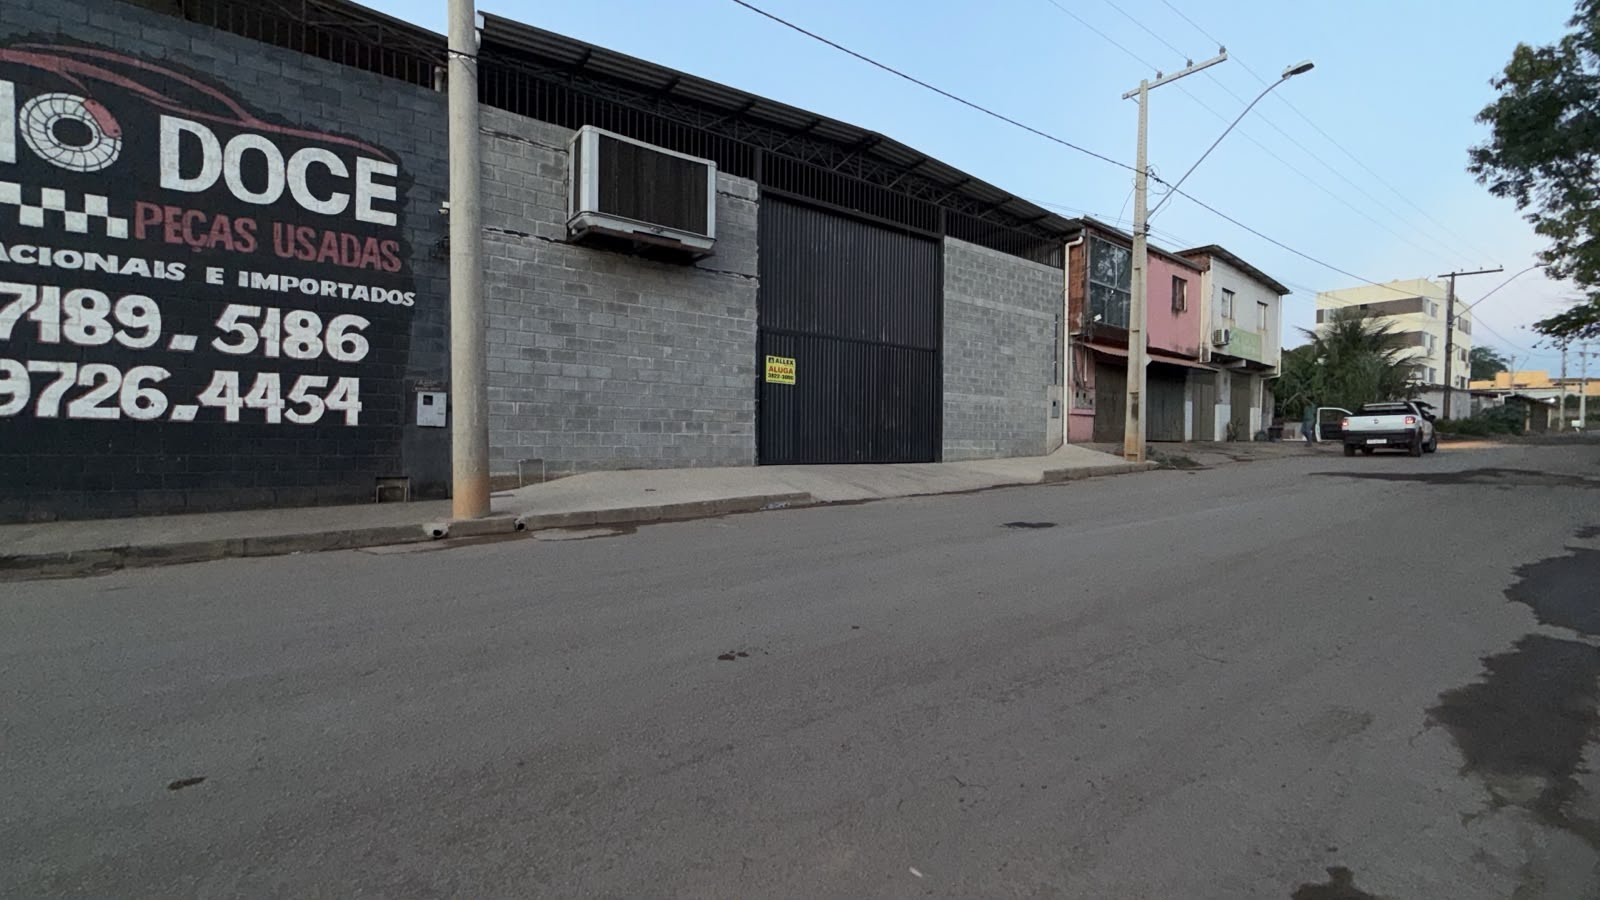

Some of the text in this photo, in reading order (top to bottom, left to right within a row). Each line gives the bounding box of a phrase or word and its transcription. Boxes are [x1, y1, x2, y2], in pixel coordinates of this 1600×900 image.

[160, 114, 398, 226] DOCE
[135, 200, 401, 272] PEÇAS USADAS
[206, 266, 225, 285] E
[238, 271, 416, 307] IMPORTADOS
[768, 366, 794, 374] ALUGA
